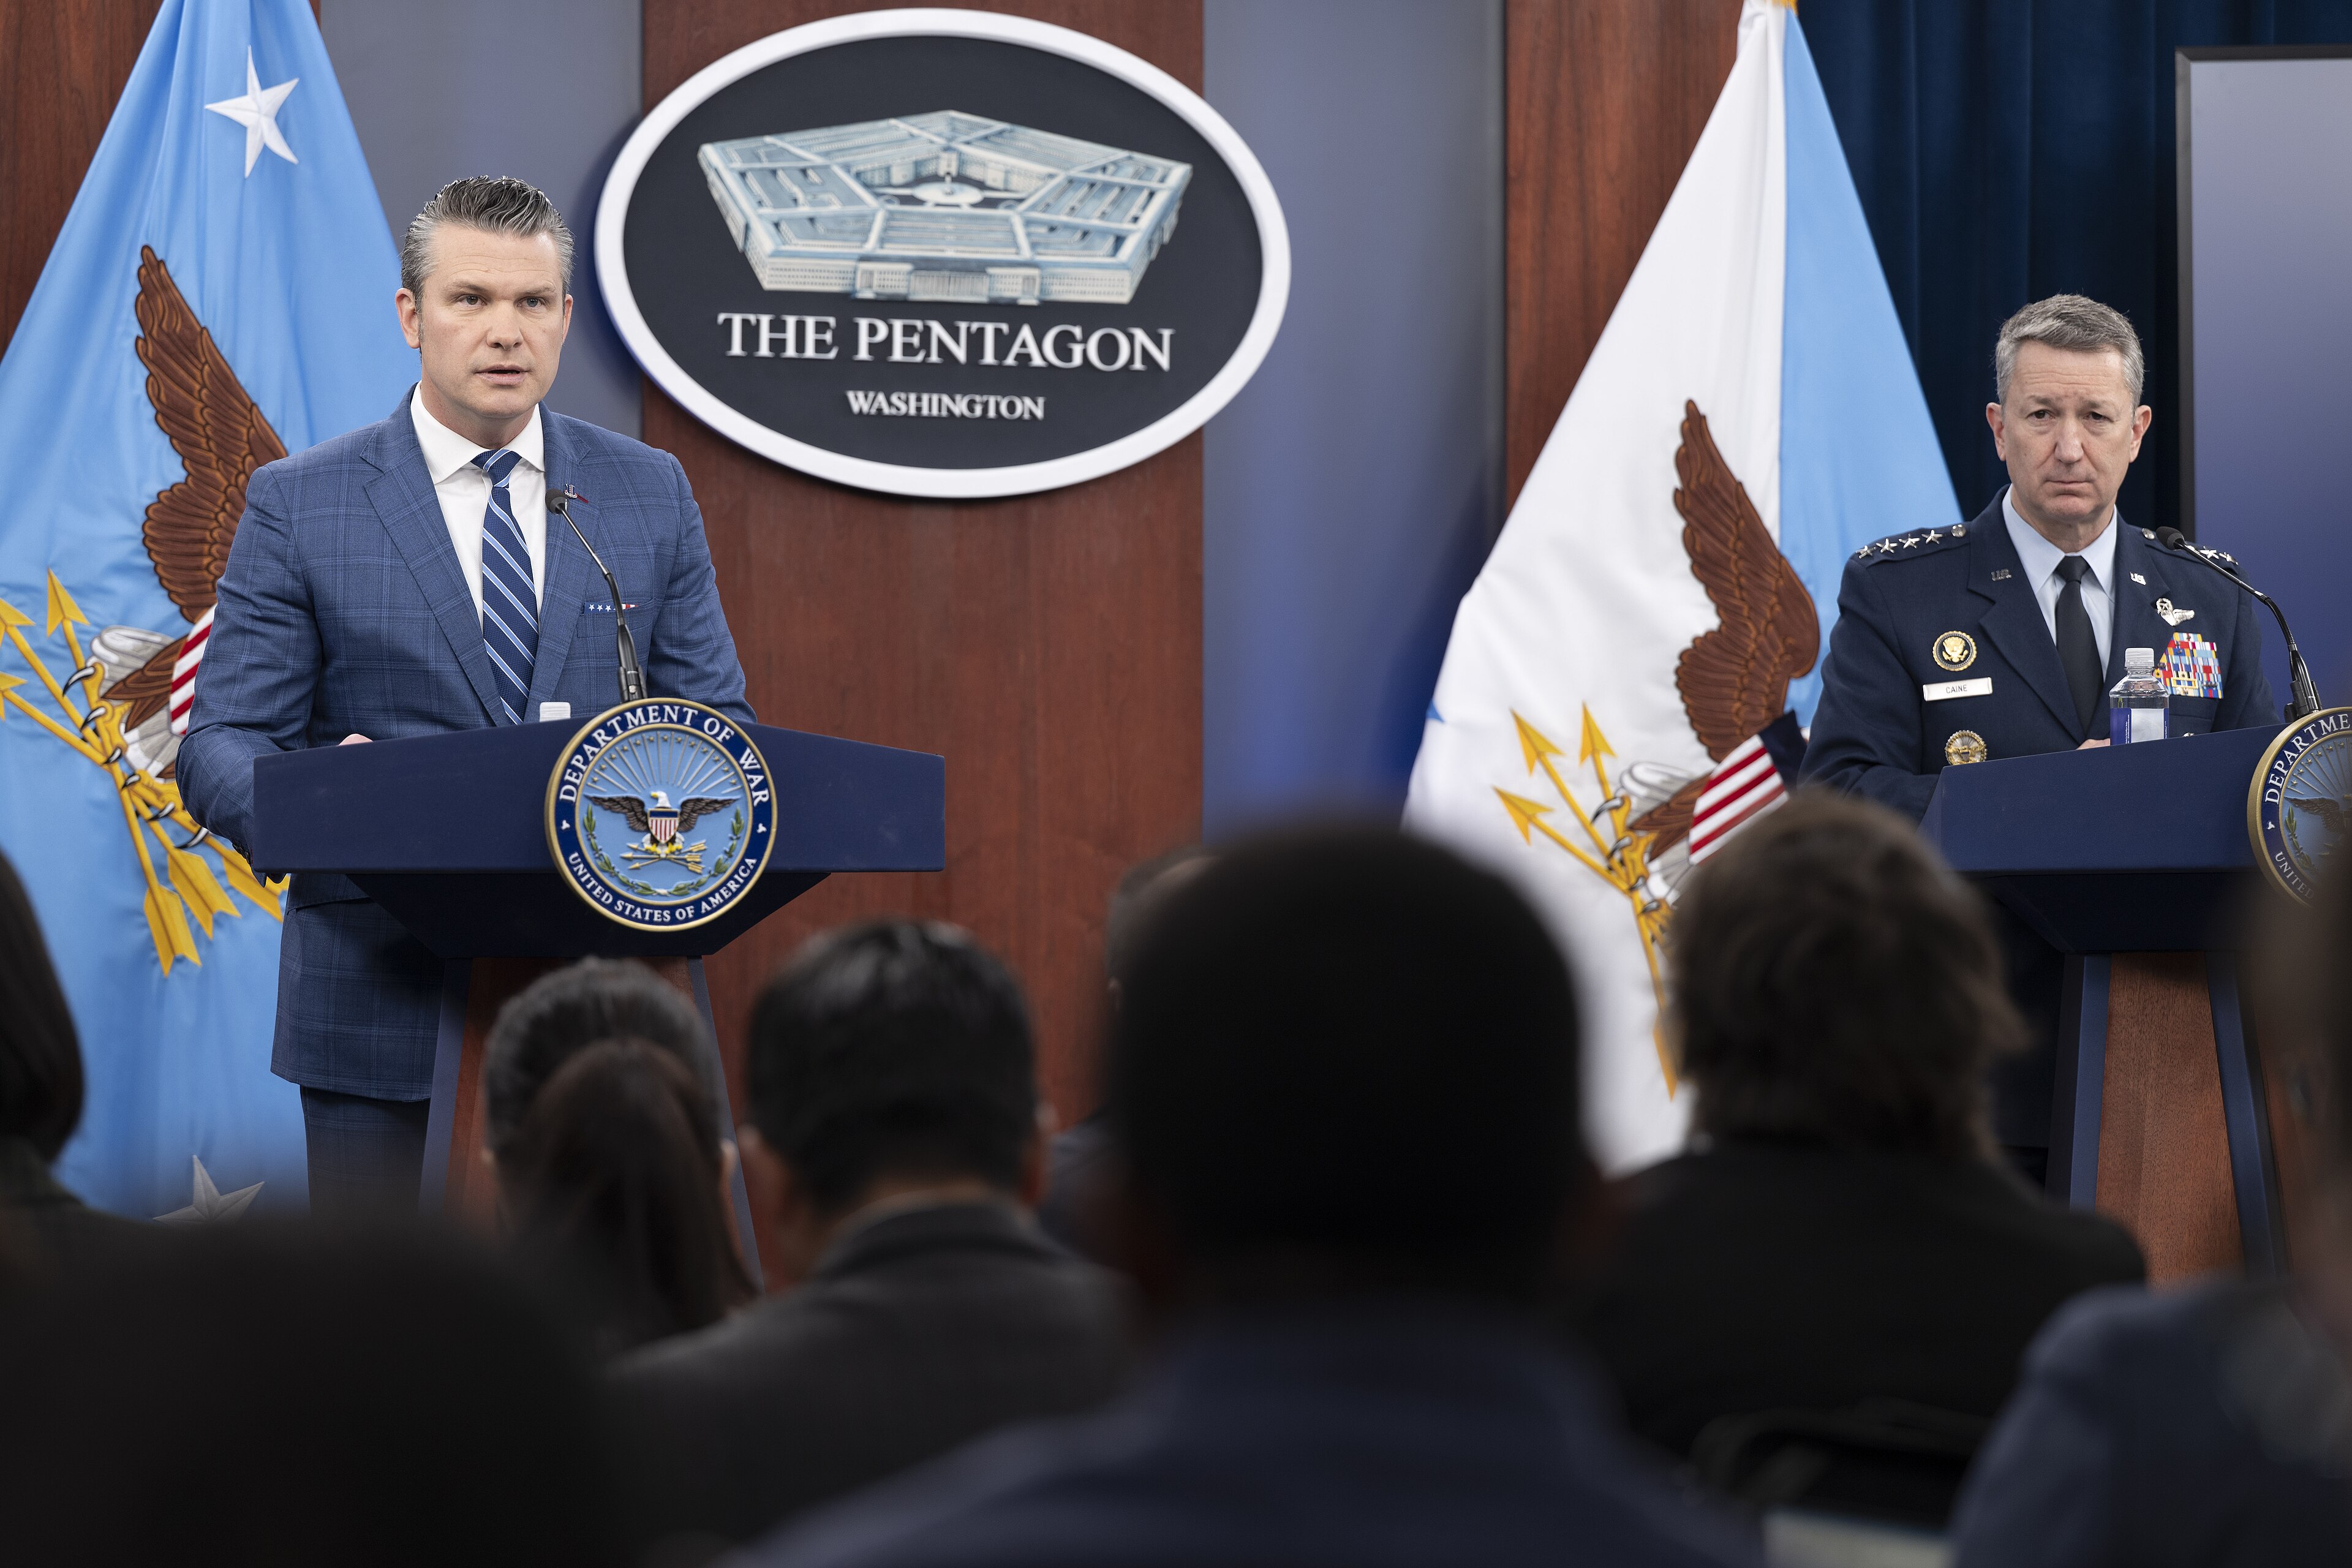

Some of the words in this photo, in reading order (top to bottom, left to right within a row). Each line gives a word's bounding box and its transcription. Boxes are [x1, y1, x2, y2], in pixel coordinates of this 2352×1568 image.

[717, 312, 839, 360] THE
[853, 317, 1176, 372] PENTAGON
[846, 390, 1046, 420] WASHINGTON
[1946, 685, 1968, 694] CAINE
[559, 705, 698, 804] DEPARTMENT
[703, 718, 735, 743] OF
[739, 746, 769, 807] WAR
[568, 852, 613, 905] UNITED
[614, 900, 671, 922] STATES
[675, 906, 695, 920] OF
[700, 858, 758, 914] AMERICA
[2275, 851, 2314, 899] UNITED
